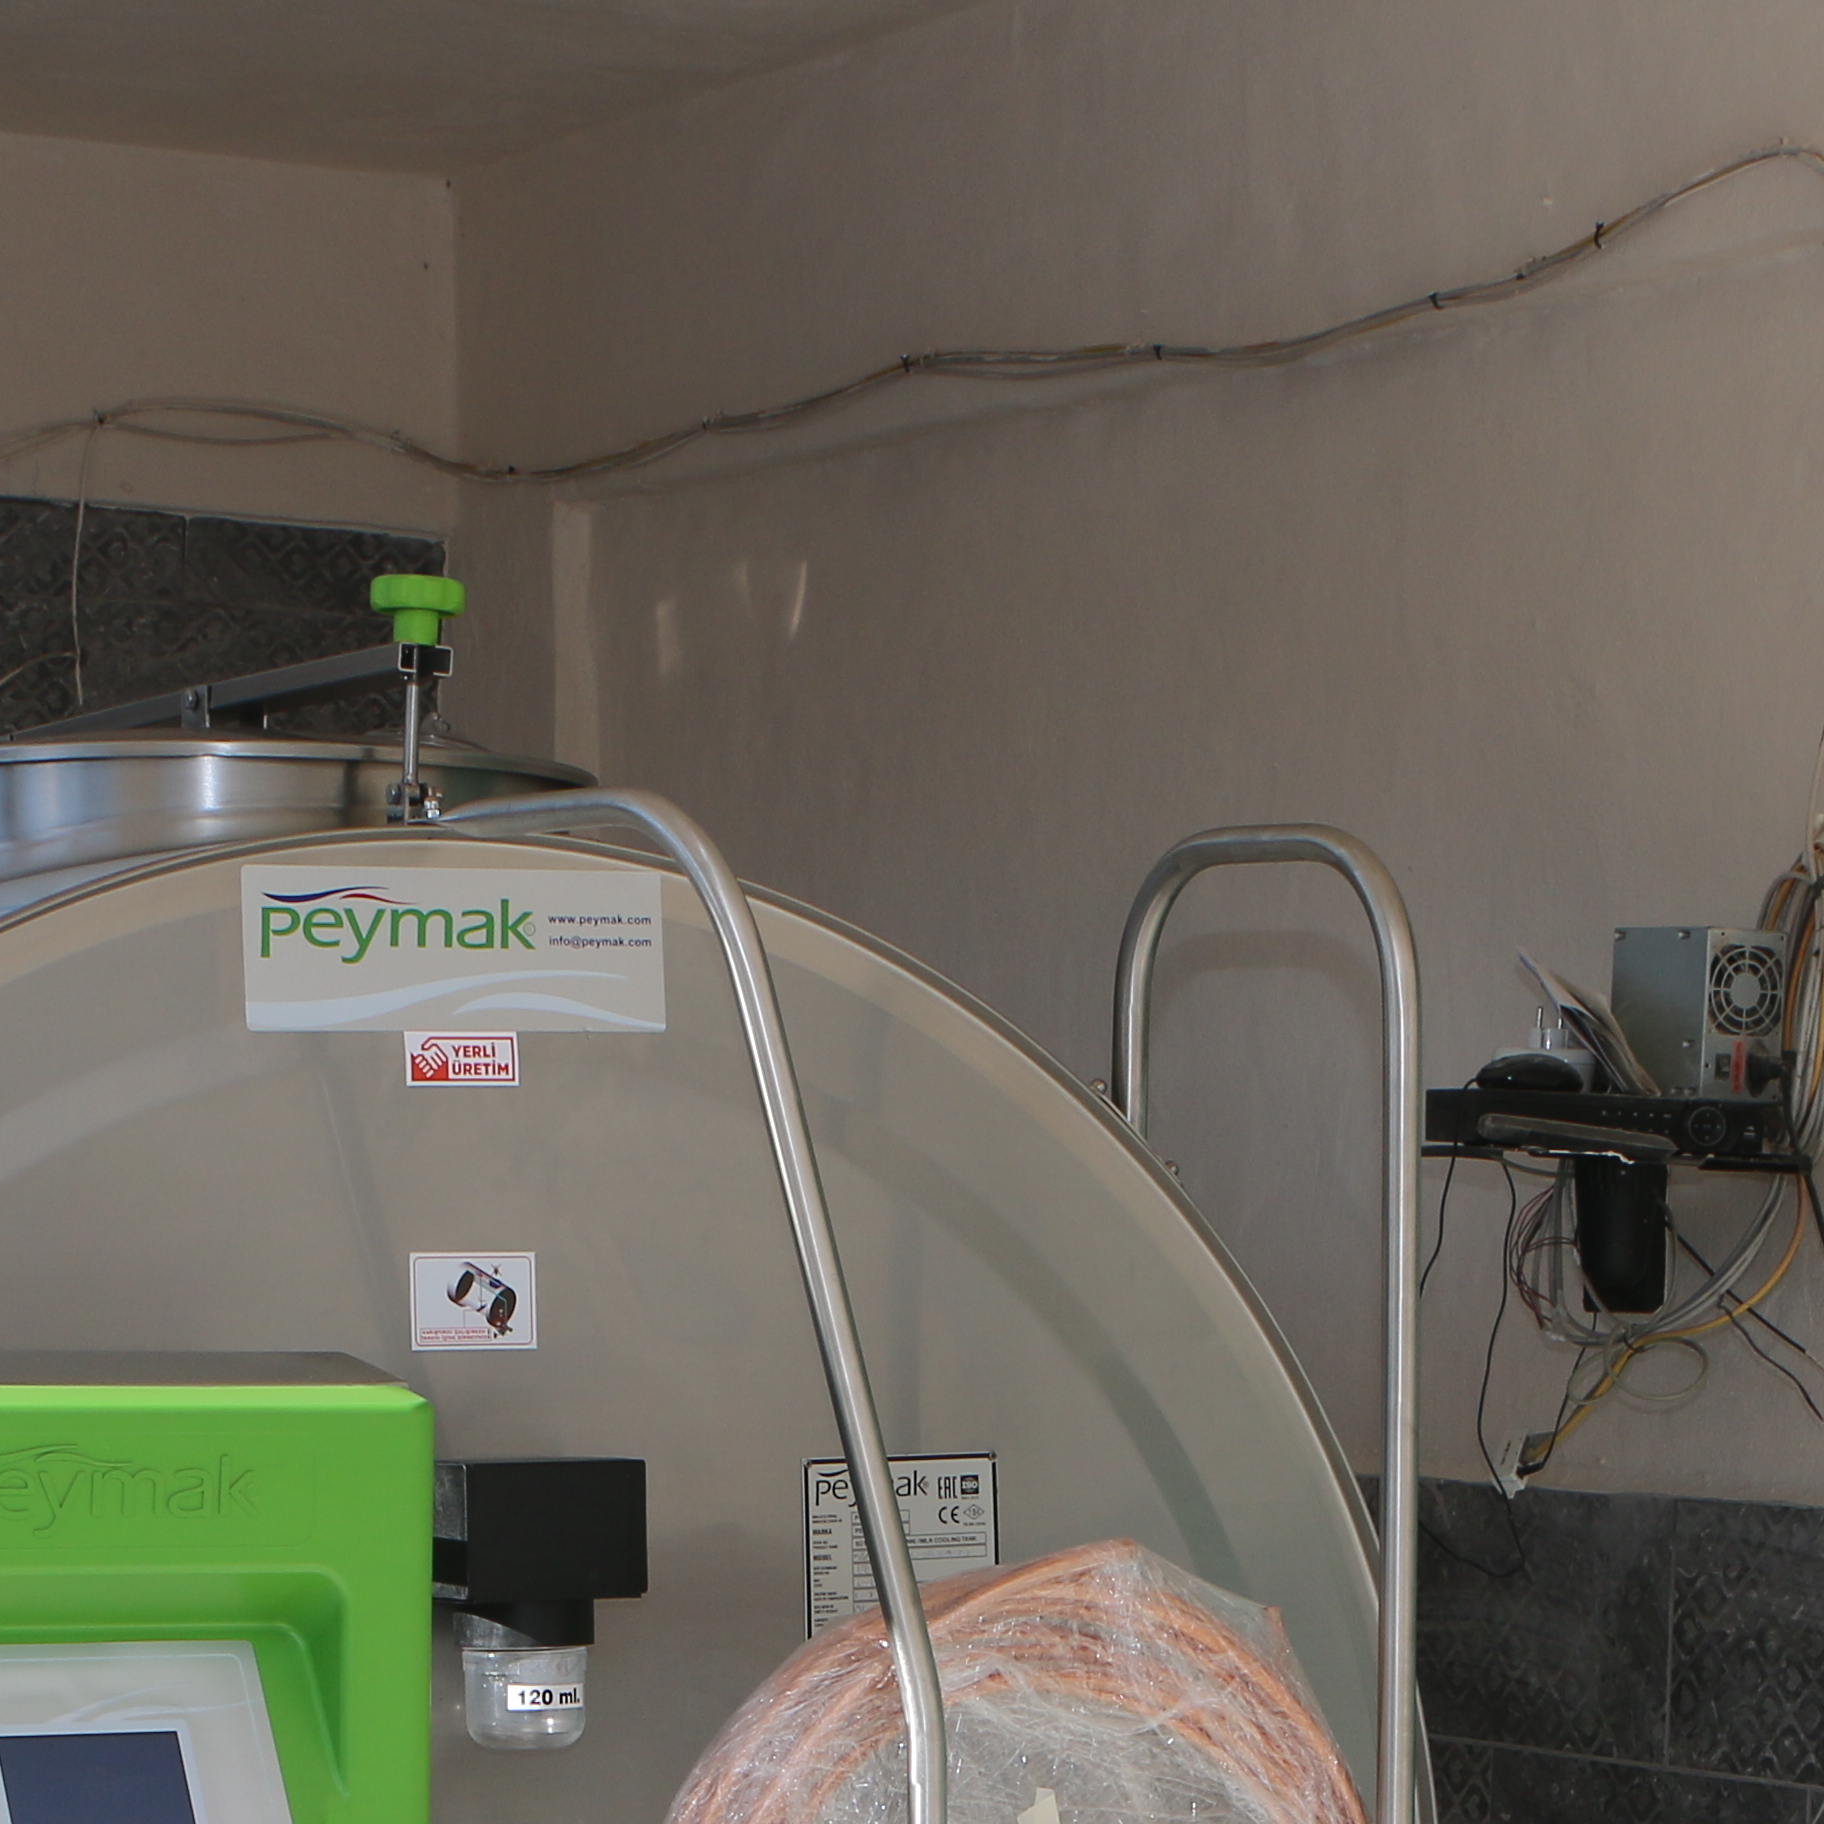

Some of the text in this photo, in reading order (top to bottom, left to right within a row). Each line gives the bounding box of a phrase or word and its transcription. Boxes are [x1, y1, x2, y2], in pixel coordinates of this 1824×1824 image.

[547, 914, 652, 927] www.peymak.com
[260, 898, 536, 965] peymak
[548, 936, 652, 949] info@peymak.com
[452, 1041, 496, 1059] YERLİ
[452, 1058, 510, 1077] ÜRETİM
[815, 1470, 928, 1507] peak
[518, 1686, 581, 1706] 120 ml.
